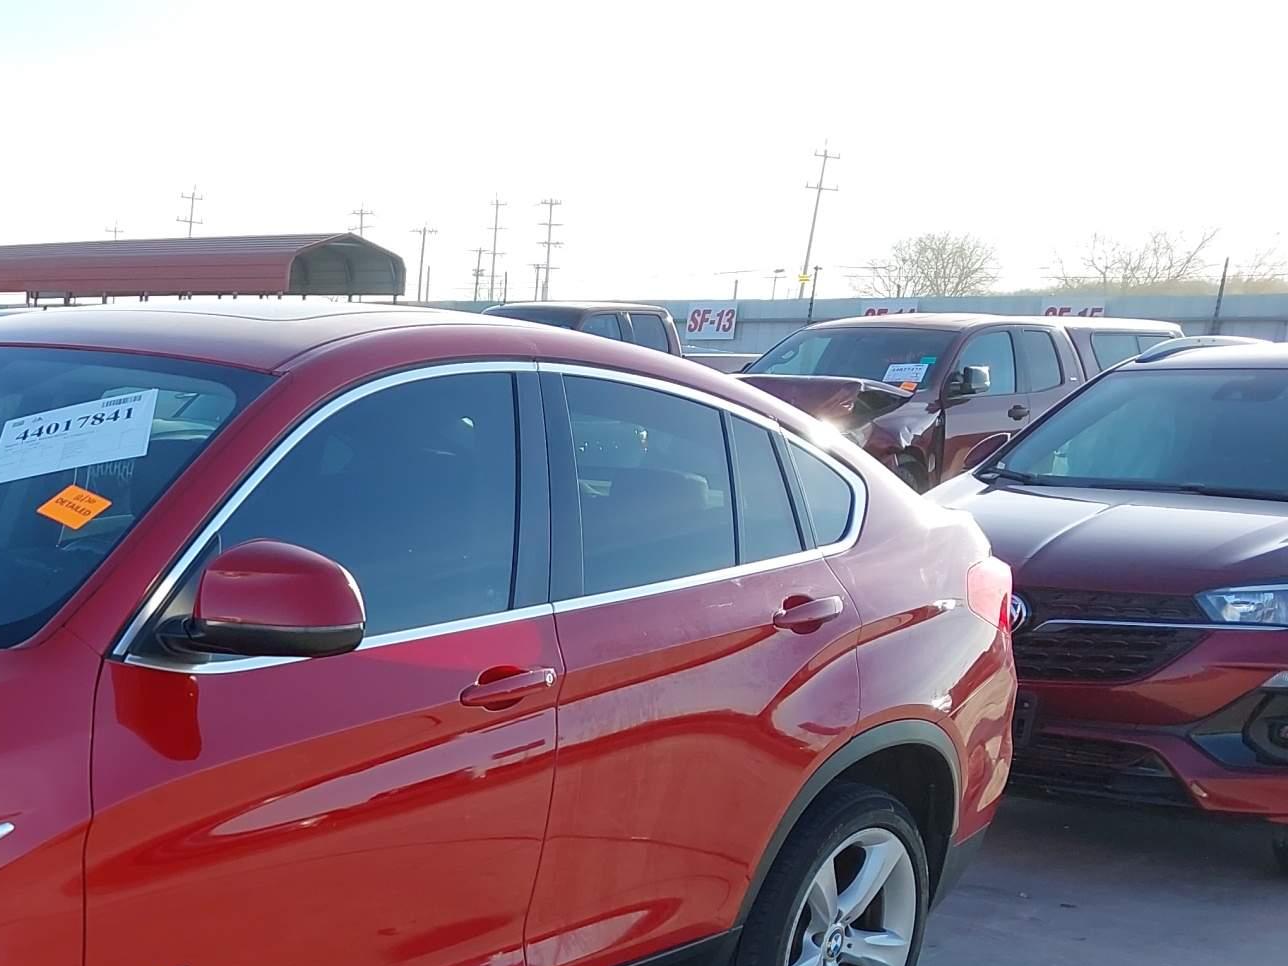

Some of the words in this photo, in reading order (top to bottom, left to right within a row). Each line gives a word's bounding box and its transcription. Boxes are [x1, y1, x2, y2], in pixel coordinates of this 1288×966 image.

[687, 309, 736, 332] SF-13
[15, 407, 134, 441] 44017841
[54, 496, 92, 517] DETAILED
